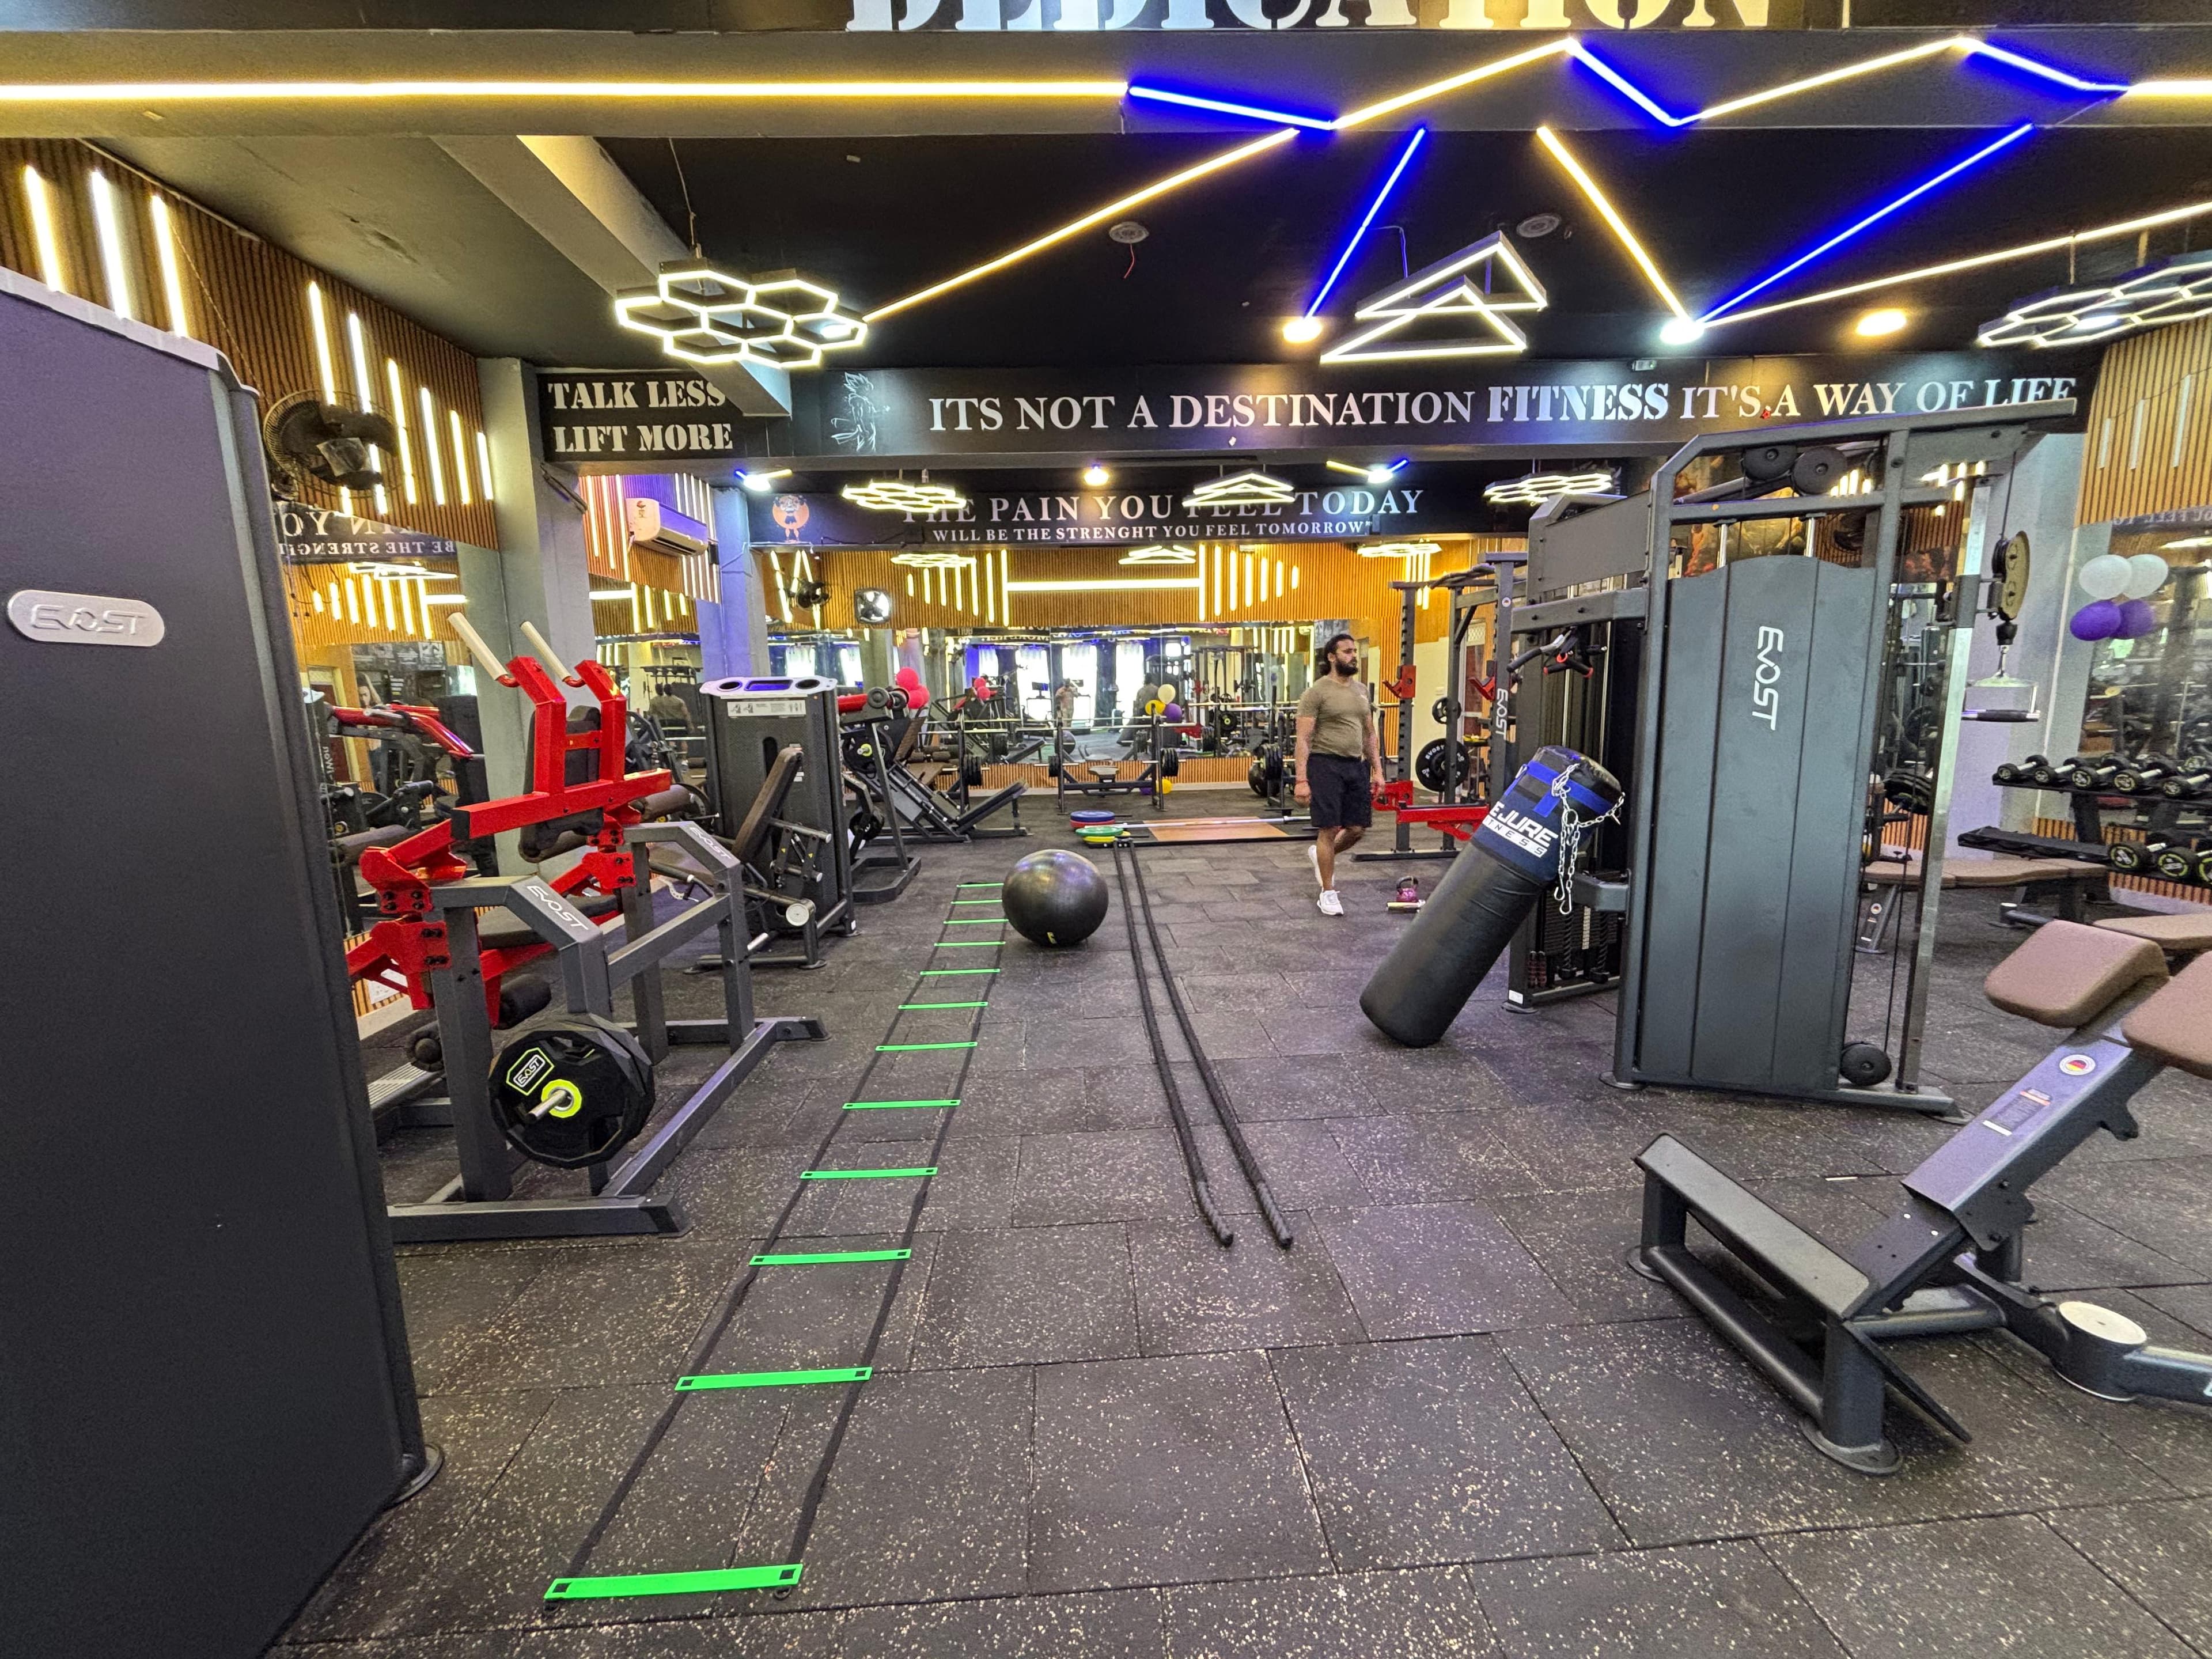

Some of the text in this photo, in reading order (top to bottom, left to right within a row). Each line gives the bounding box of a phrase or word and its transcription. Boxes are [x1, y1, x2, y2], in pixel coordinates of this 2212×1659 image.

[548, 380, 726, 409] TALK LESS
[928, 377, 2076, 431] ITS NOT A DESTINATION FITNESS IT'S A WAY OF LIFE
[552, 423, 733, 453] LIFT MORE
[989, 497, 1080, 522] PAIN
[1092, 494, 1173, 520] YOU
[1294, 490, 1423, 516] TODAY
[933, 529, 980, 541] WILL
[986, 529, 1008, 541] BE
[1013, 528, 1051, 540] THE
[1055, 525, 1157, 540] STRENGHT
[1163, 525, 1199, 537] YOU
[1206, 524, 1250, 536] FEEL
[1752, 626, 1783, 730] EVOST
[1496, 688, 1508, 740] EVOST
[690, 827, 732, 859] EVOST
[527, 885, 589, 930] EVOST
[518, 1058, 540, 1084] EVOST
